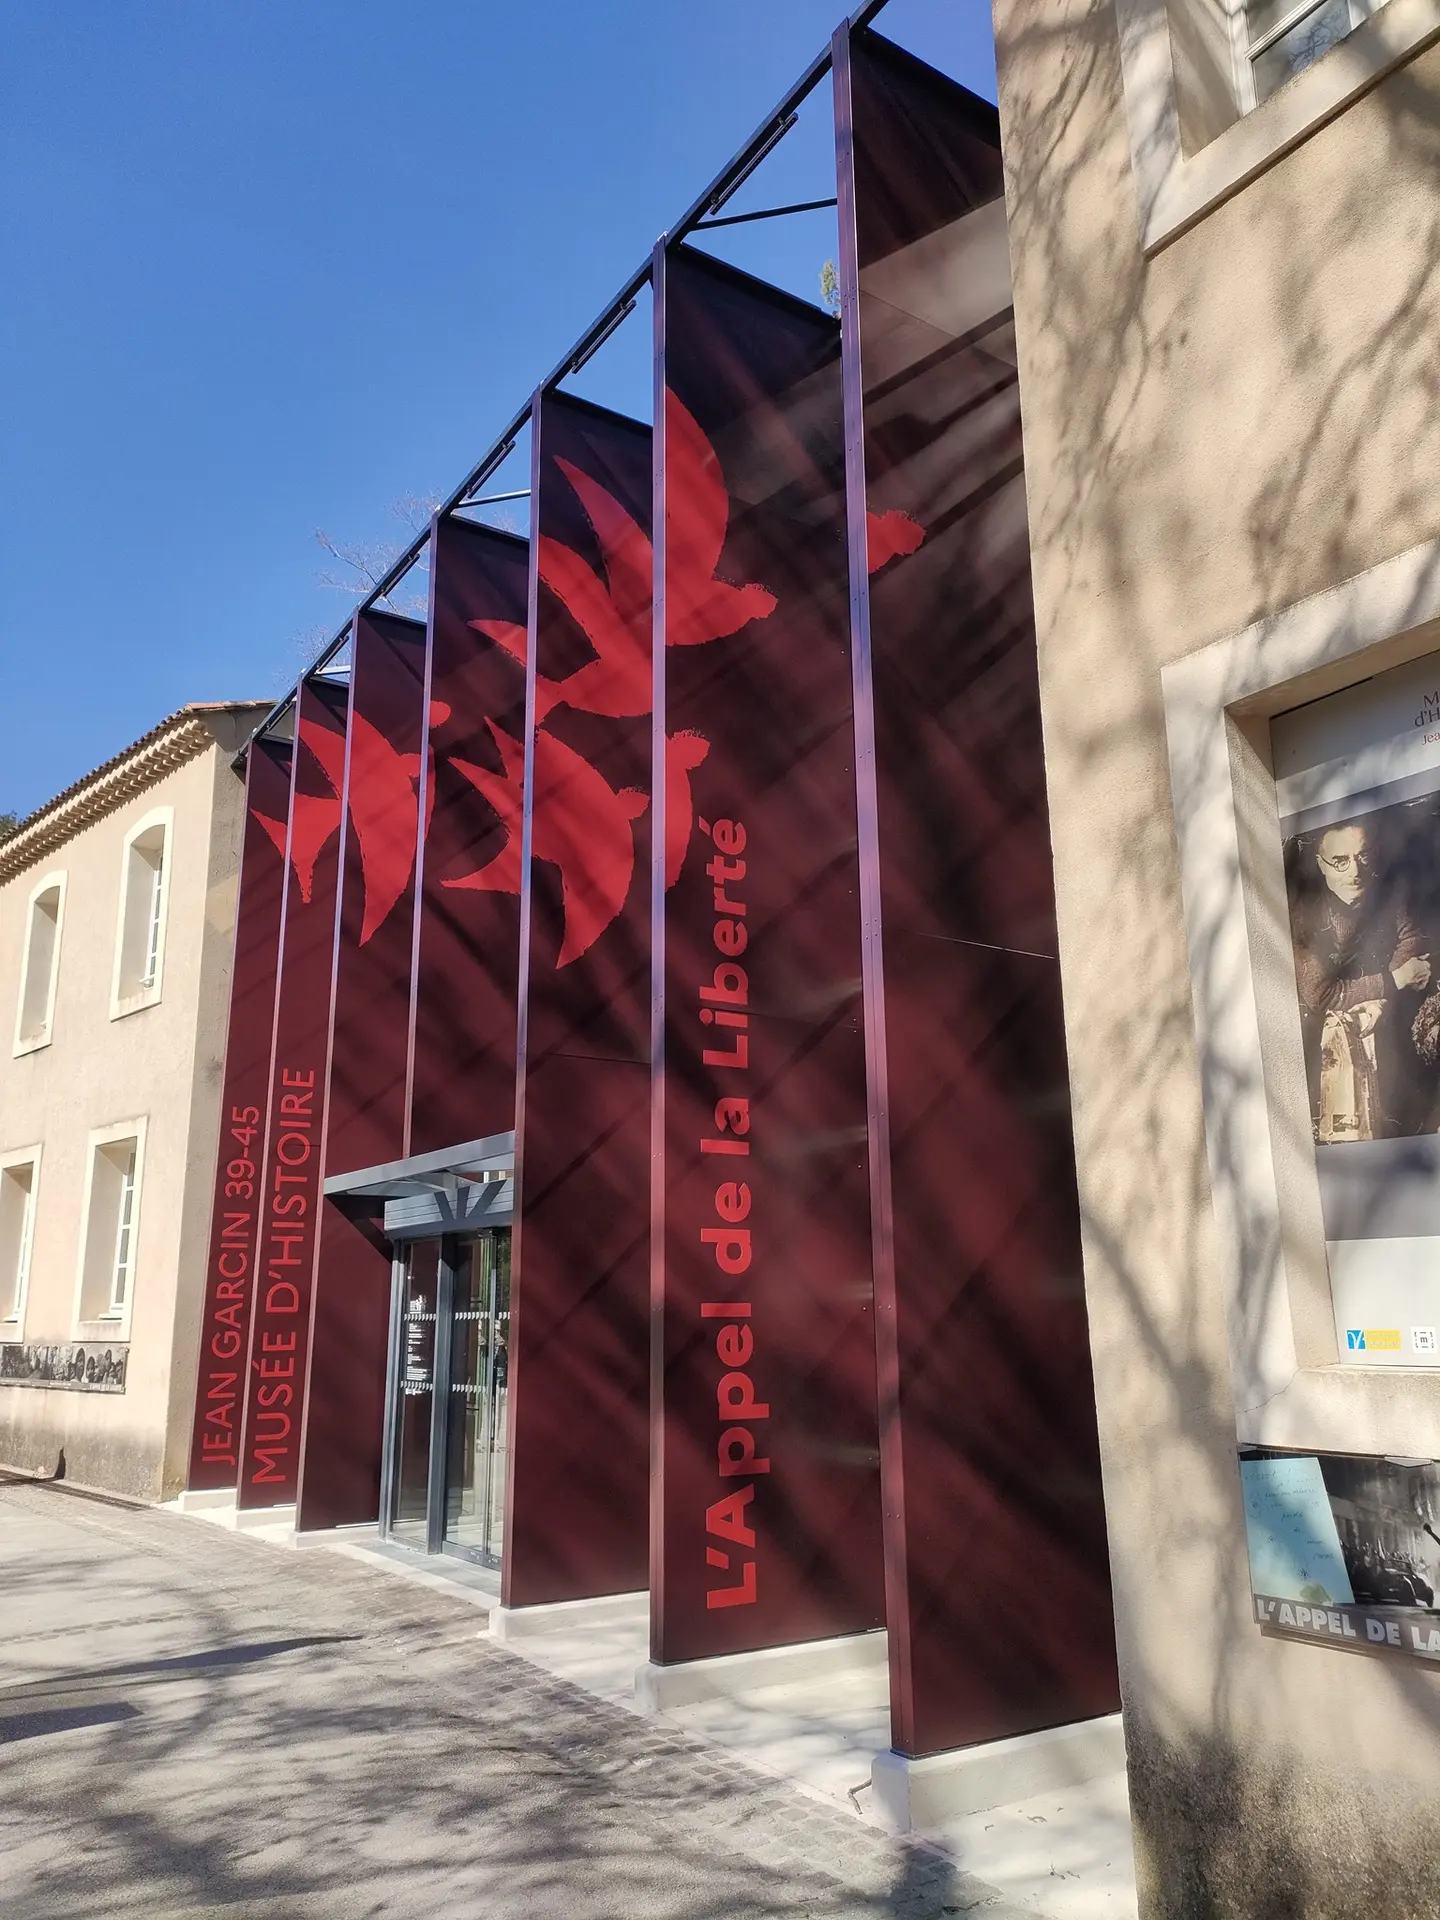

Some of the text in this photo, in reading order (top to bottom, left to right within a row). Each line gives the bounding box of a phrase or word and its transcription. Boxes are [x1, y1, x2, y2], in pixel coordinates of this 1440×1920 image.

[202, 1106, 259, 1466] JEAN GARCIN 39-45
[251, 1068, 315, 1483] MUSÉE D'HISTOIRE
[699, 815, 770, 1609] L'Appel de la Liberté
[1256, 1598, 1357, 1637] L'APPEL
[1366, 1618, 1402, 1647] DE
